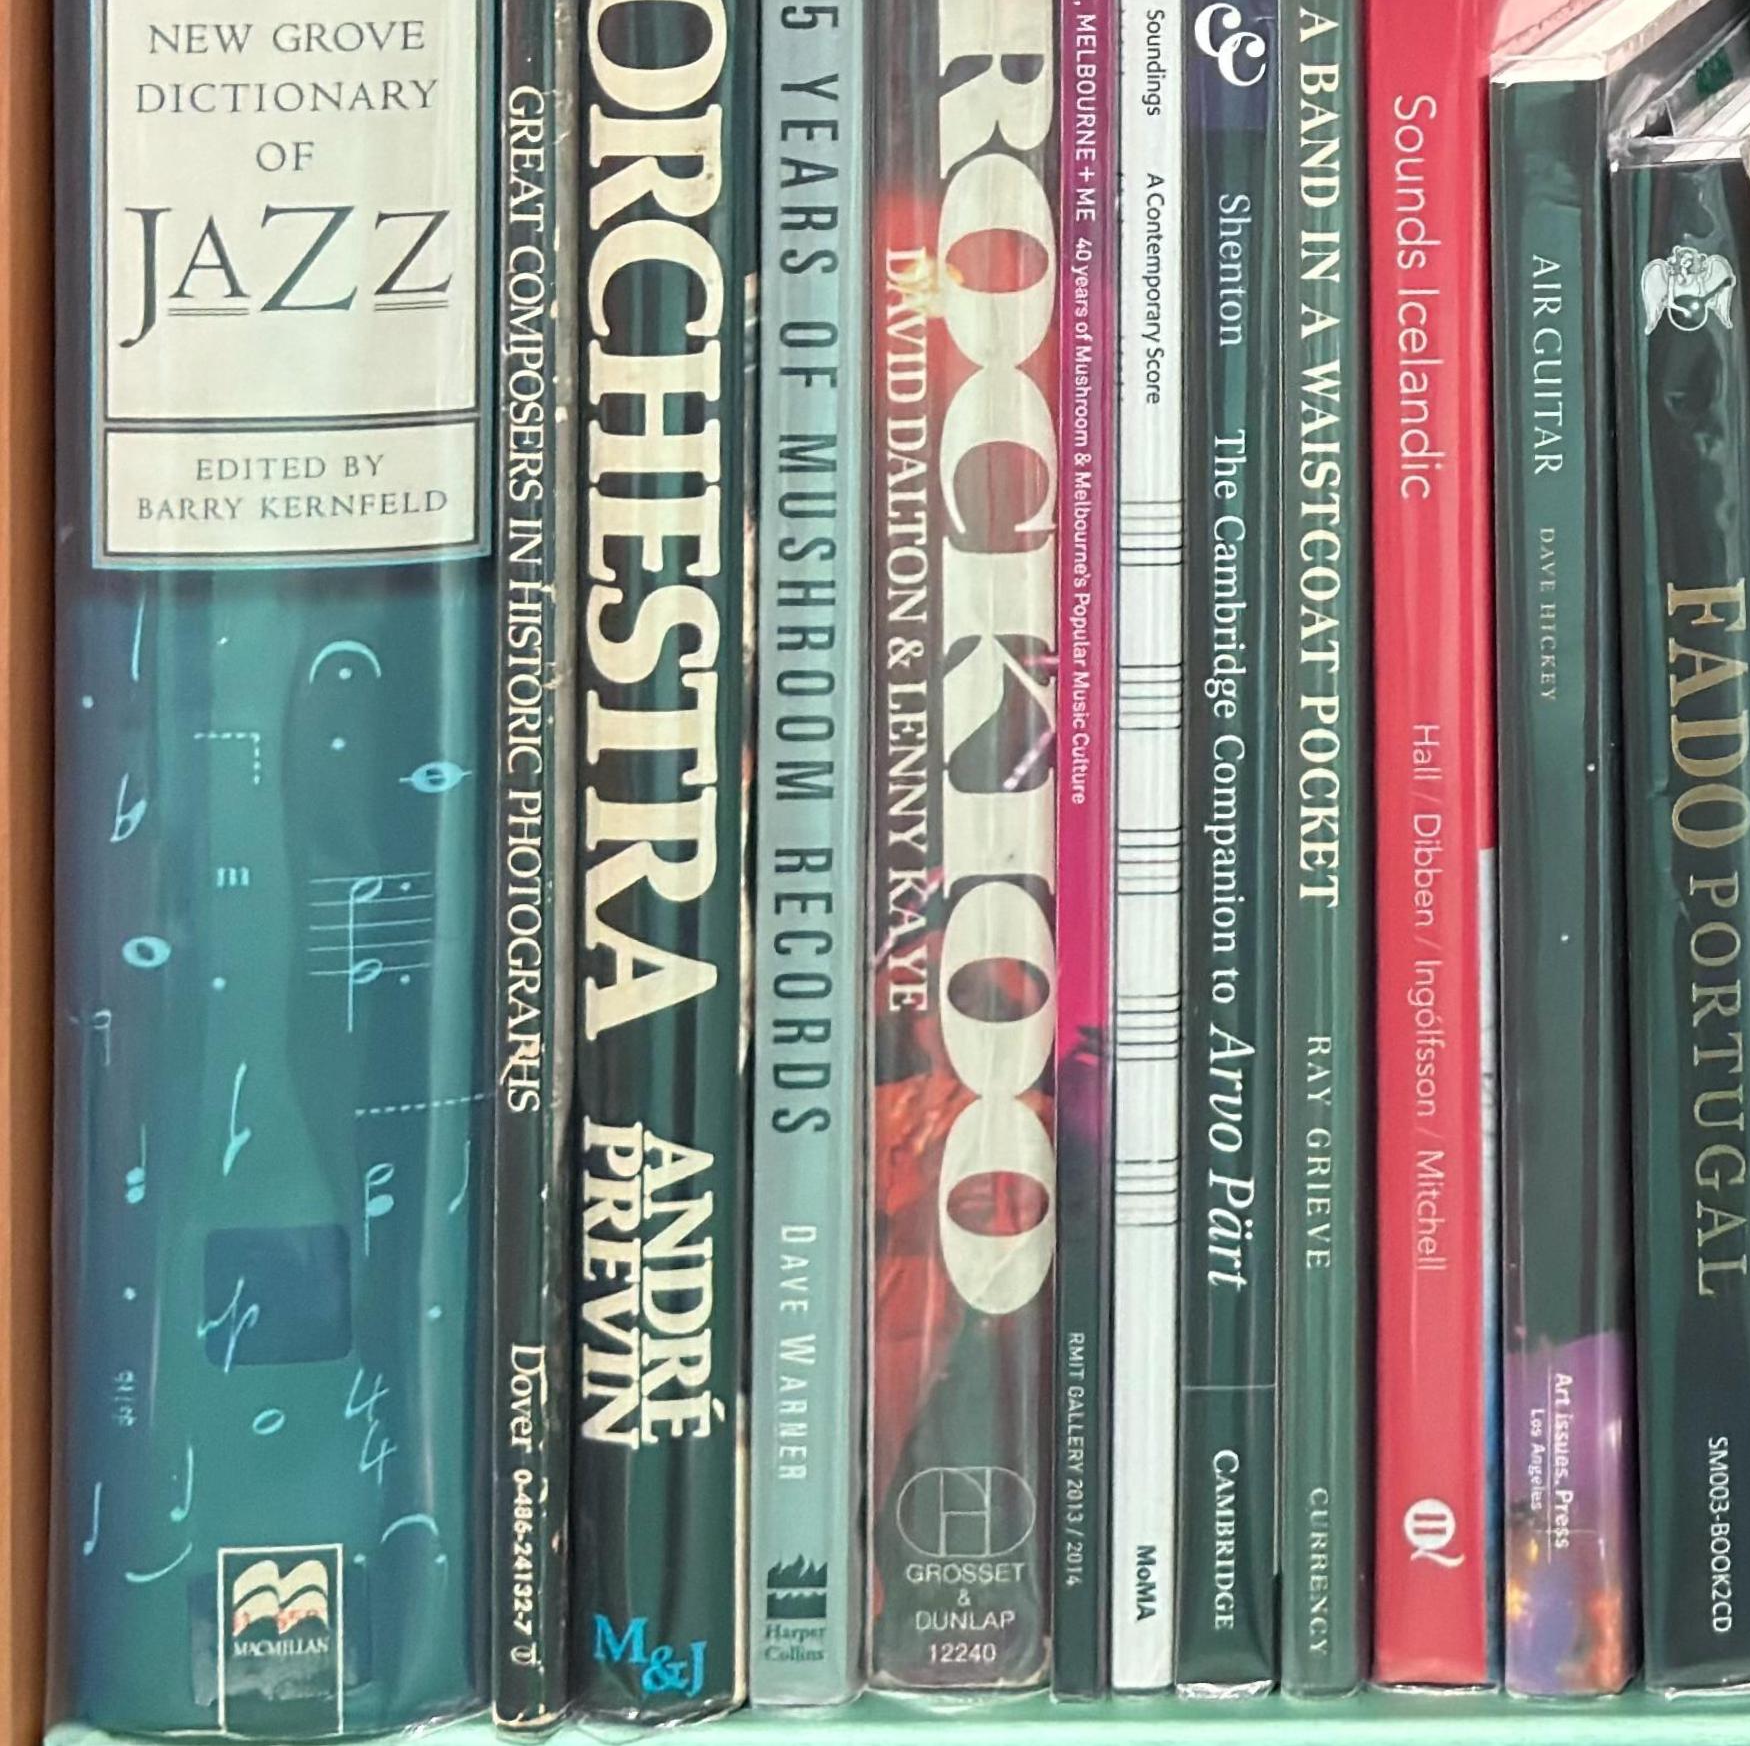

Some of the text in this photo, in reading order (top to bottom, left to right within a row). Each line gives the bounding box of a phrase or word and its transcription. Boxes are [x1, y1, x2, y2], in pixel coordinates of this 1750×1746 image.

[135, 79, 439, 115] DICTIONARY
[148, 20, 426, 55] NEW GROVE
[1074, 14, 1097, 161] MELBOURNE
[1141, 9, 1165, 115] Soundings
[255, 142, 315, 173] OF
[779, 74, 838, 275] YEARS
[1074, 189, 1097, 221] ME
[1078, 166, 1094, 184] +
[119, 205, 452, 349] JAZZ
[1141, 172, 1165, 404] A Contemporary Score
[1216, 193, 1251, 347] Shenton
[1391, 95, 1446, 501] Sounds Icelandic
[779, 321, 838, 389] OF
[1530, 254, 1563, 476] AIR GUITAR
[137, 489, 448, 521] BARRY KERNFELD
[196, 453, 384, 483] EDITED BY
[1068, 237, 1093, 803] 40 years of Mushroom & Melbourne's Popular Music Culture
[1298, 6, 1341, 907] A BAND IN A WAISTCOAT POCKET
[503, 85, 544, 1112] GREAT COMPOSERS IN HISTORIC PHOTOGRAPHS
[775, 433, 838, 802] MUSHROOM
[885, 246, 928, 1012] DAVID DALTON & LENNY KAYE
[1538, 527, 1556, 701] DAVE HICKEY
[1410, 723, 1440, 781] Hall
[1203, 429, 1254, 1292] The Cambridge Companion to Arvo Pärt
[1410, 813, 1441, 927] Dibben
[771, 847, 833, 1135] RECORDS
[1405, 958, 1443, 1116] Ingólfsson
[1304, 1036, 1331, 1270] RAY GRIEVE
[1686, 871, 1747, 1297] PORTUGAL
[581, 1115, 644, 1448] PREVIN
[1413, 1150, 1445, 1271] Mitchell
[640, 1130, 724, 1444] ANDRÉ
[1065, 1331, 1085, 1379] RMIT
[508, 1343, 543, 1633] Dover 0-486-24132-7
[1065, 1385, 1085, 1474] GALLERY
[1065, 1477, 1084, 1521] 2013
[1526, 1407, 1545, 1512] Los Angeles
[1553, 1373, 1574, 1549] Art issues. Press
[906, 1563, 1025, 1583] GROSSET
[957, 1589, 971, 1606] &
[1064, 1541, 1084, 1585] 2014
[1134, 1543, 1156, 1619] MoMA
[1211, 1449, 1239, 1630] CAMBRIDGE
[1306, 1486, 1329, 1656] CURRENCY
[1705, 1437, 1732, 1633] SM003-BOOK2CD
[233, 1637, 329, 1656] MACMILLAN
[594, 1614, 707, 1697] M&J
[915, 1611, 1015, 1631] DUNLAP
[929, 1643, 997, 1662] 12240
